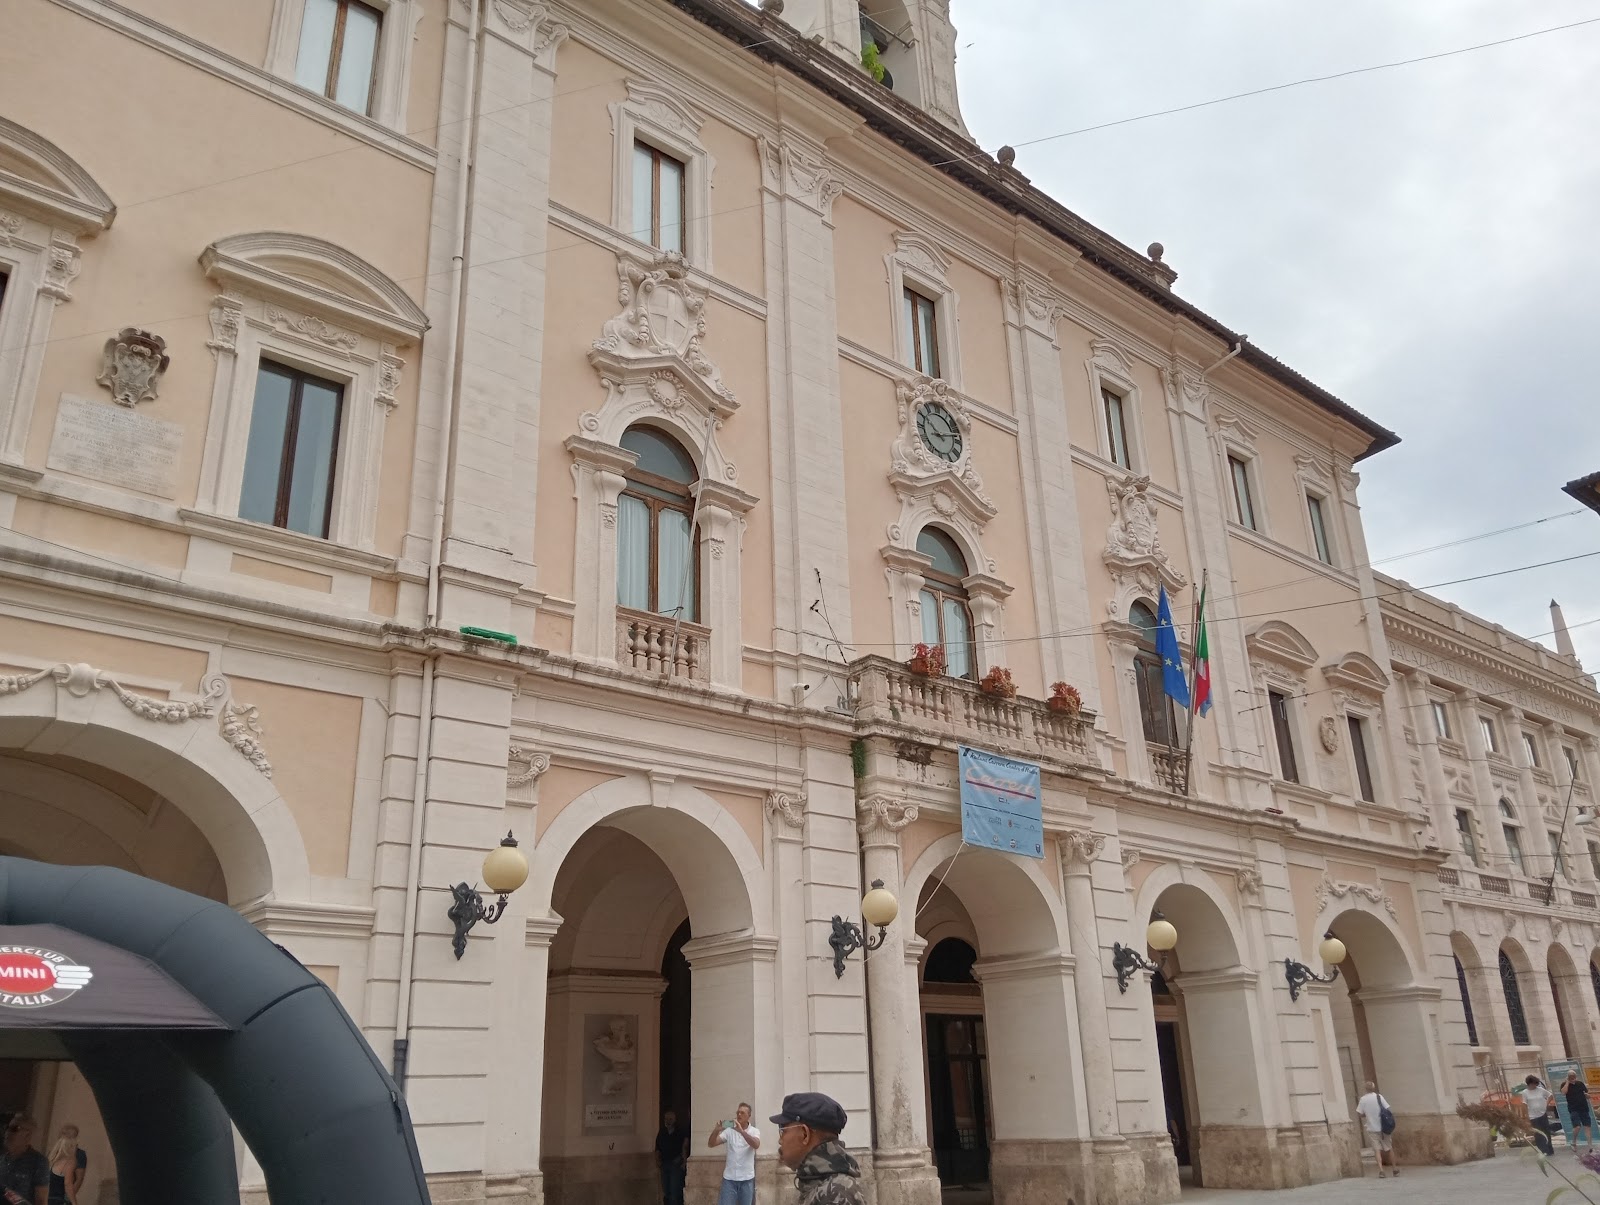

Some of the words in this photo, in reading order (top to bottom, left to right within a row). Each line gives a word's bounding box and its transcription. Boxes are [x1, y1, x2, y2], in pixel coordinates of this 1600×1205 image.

[1389, 640, 1439, 673] PALAZZO
[1440, 661, 1473, 686] DELLE
[0, 946, 65, 963] ERCLUB
[0, 966, 46, 979] MINI
[0, 992, 54, 1005] TALIA
